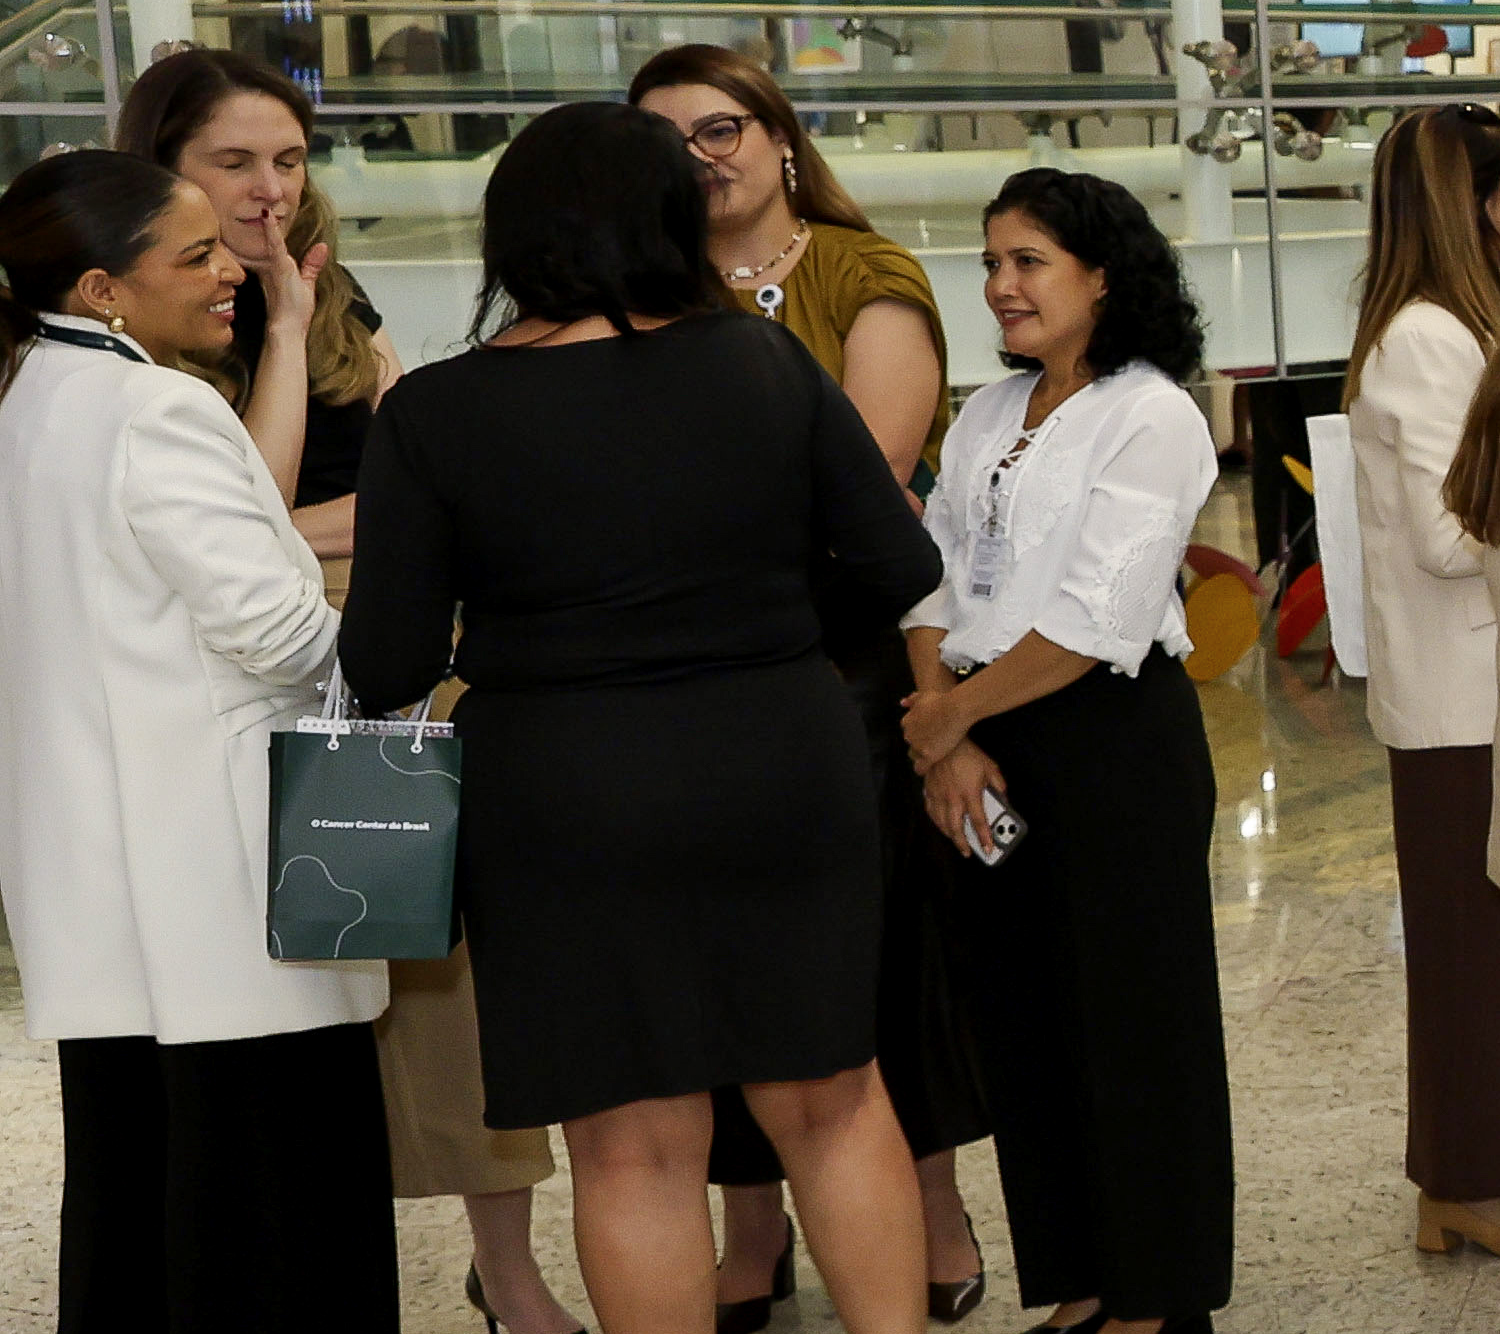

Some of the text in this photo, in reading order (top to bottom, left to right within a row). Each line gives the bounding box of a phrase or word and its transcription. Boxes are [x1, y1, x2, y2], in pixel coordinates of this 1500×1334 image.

[320, 819, 354, 830] Cancer
[355, 820, 387, 830] Center
[402, 822, 430, 831] Brasil
